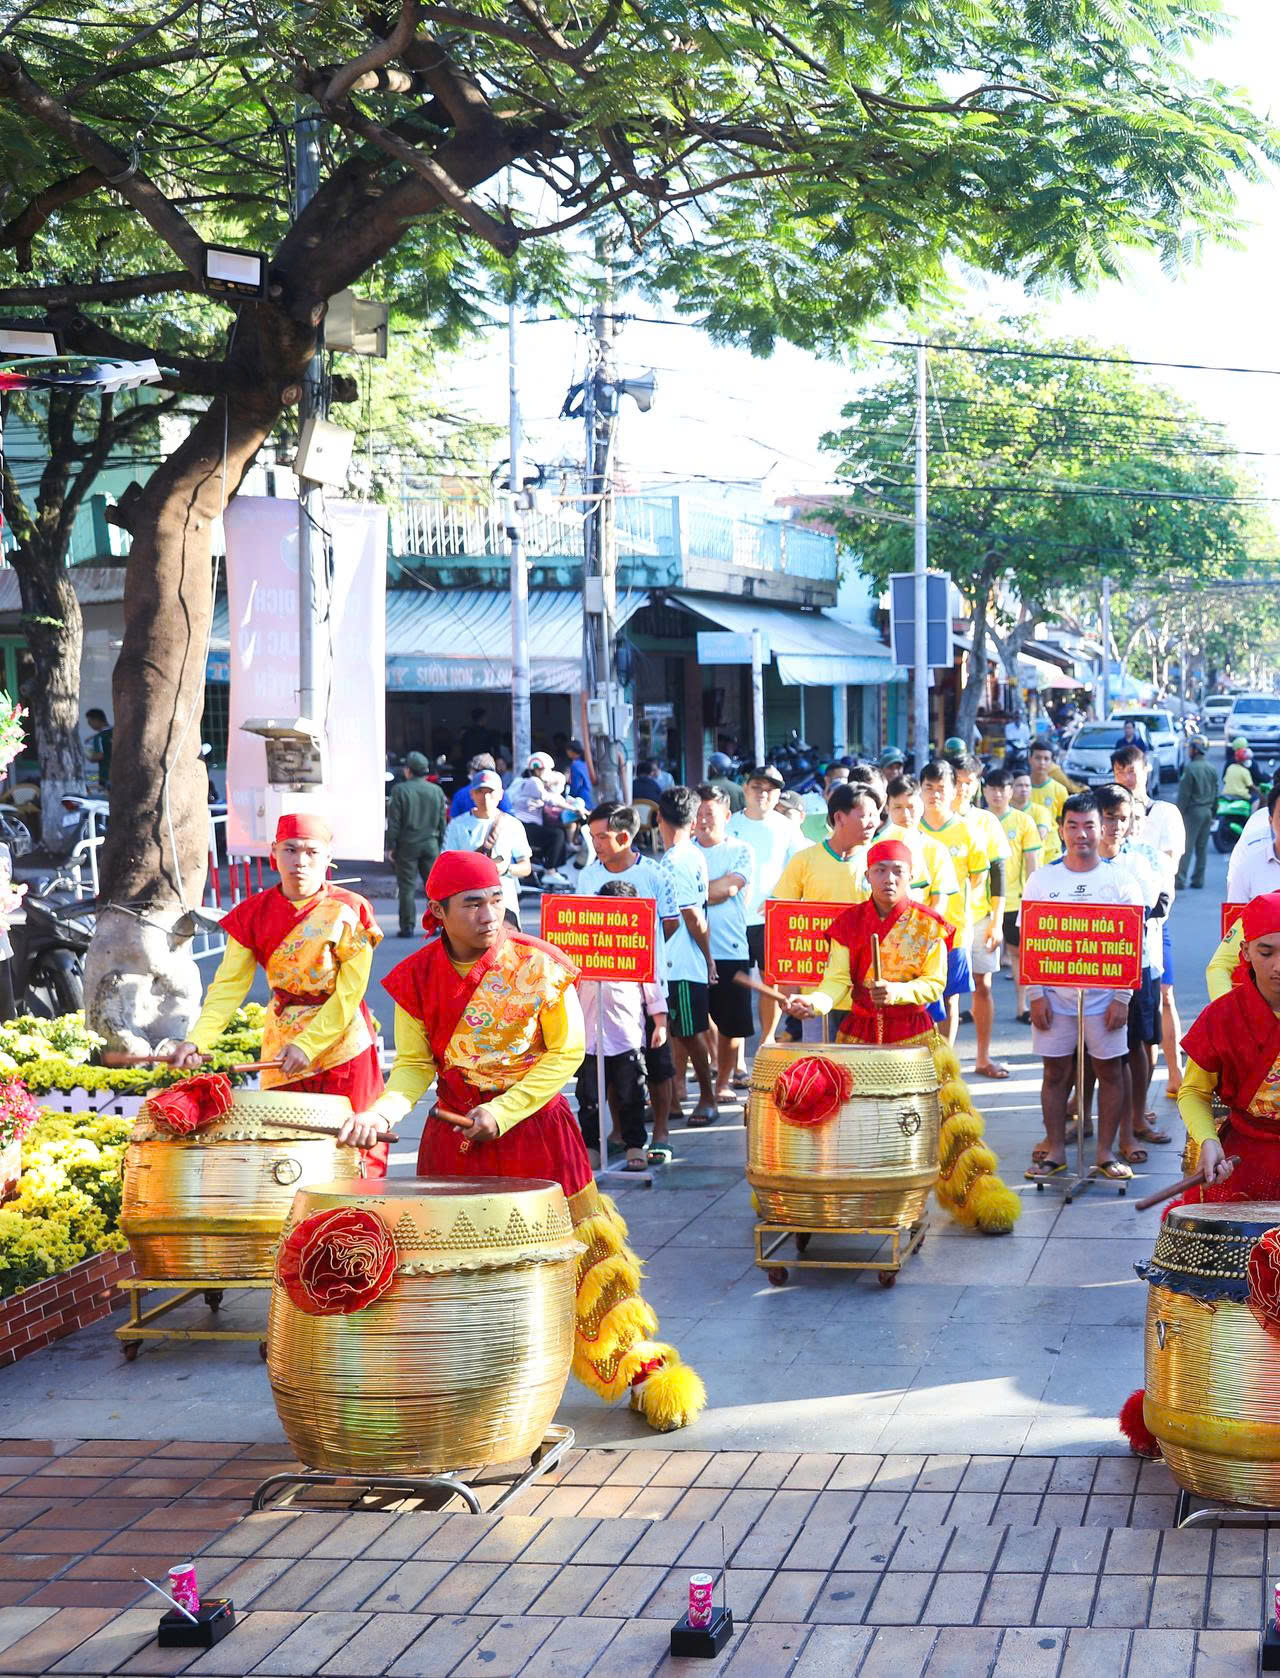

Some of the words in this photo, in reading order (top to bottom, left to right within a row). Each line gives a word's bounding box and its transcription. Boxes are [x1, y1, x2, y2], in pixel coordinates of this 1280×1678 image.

[558, 908, 576, 927] ĐỘI
[578, 909, 604, 925] BÌNH
[607, 910, 628, 926] HÒA
[631, 914, 638, 927] 2
[788, 914, 809, 932] ĐỘI
[1038, 914, 1058, 933] ĐỘI
[1061, 915, 1088, 932] BÌNH
[1091, 916, 1114, 933] HÒA
[1118, 921, 1124, 934] 1
[546, 929, 589, 947] PHƯỜNG
[592, 930, 612, 947] TÂN
[788, 936, 812, 952] TÂN
[1026, 936, 1072, 953] PHƯỜNG
[1075, 938, 1098, 954] TÂN
[585, 951, 615, 969] ĐỒNG
[617, 956, 636, 970] NAI
[777, 959, 794, 973] TP.
[796, 956, 813, 974] HỒ
[1039, 956, 1065, 974] TỈNH
[1067, 957, 1099, 975] ĐỒNG
[1102, 963, 1122, 977] NAI
